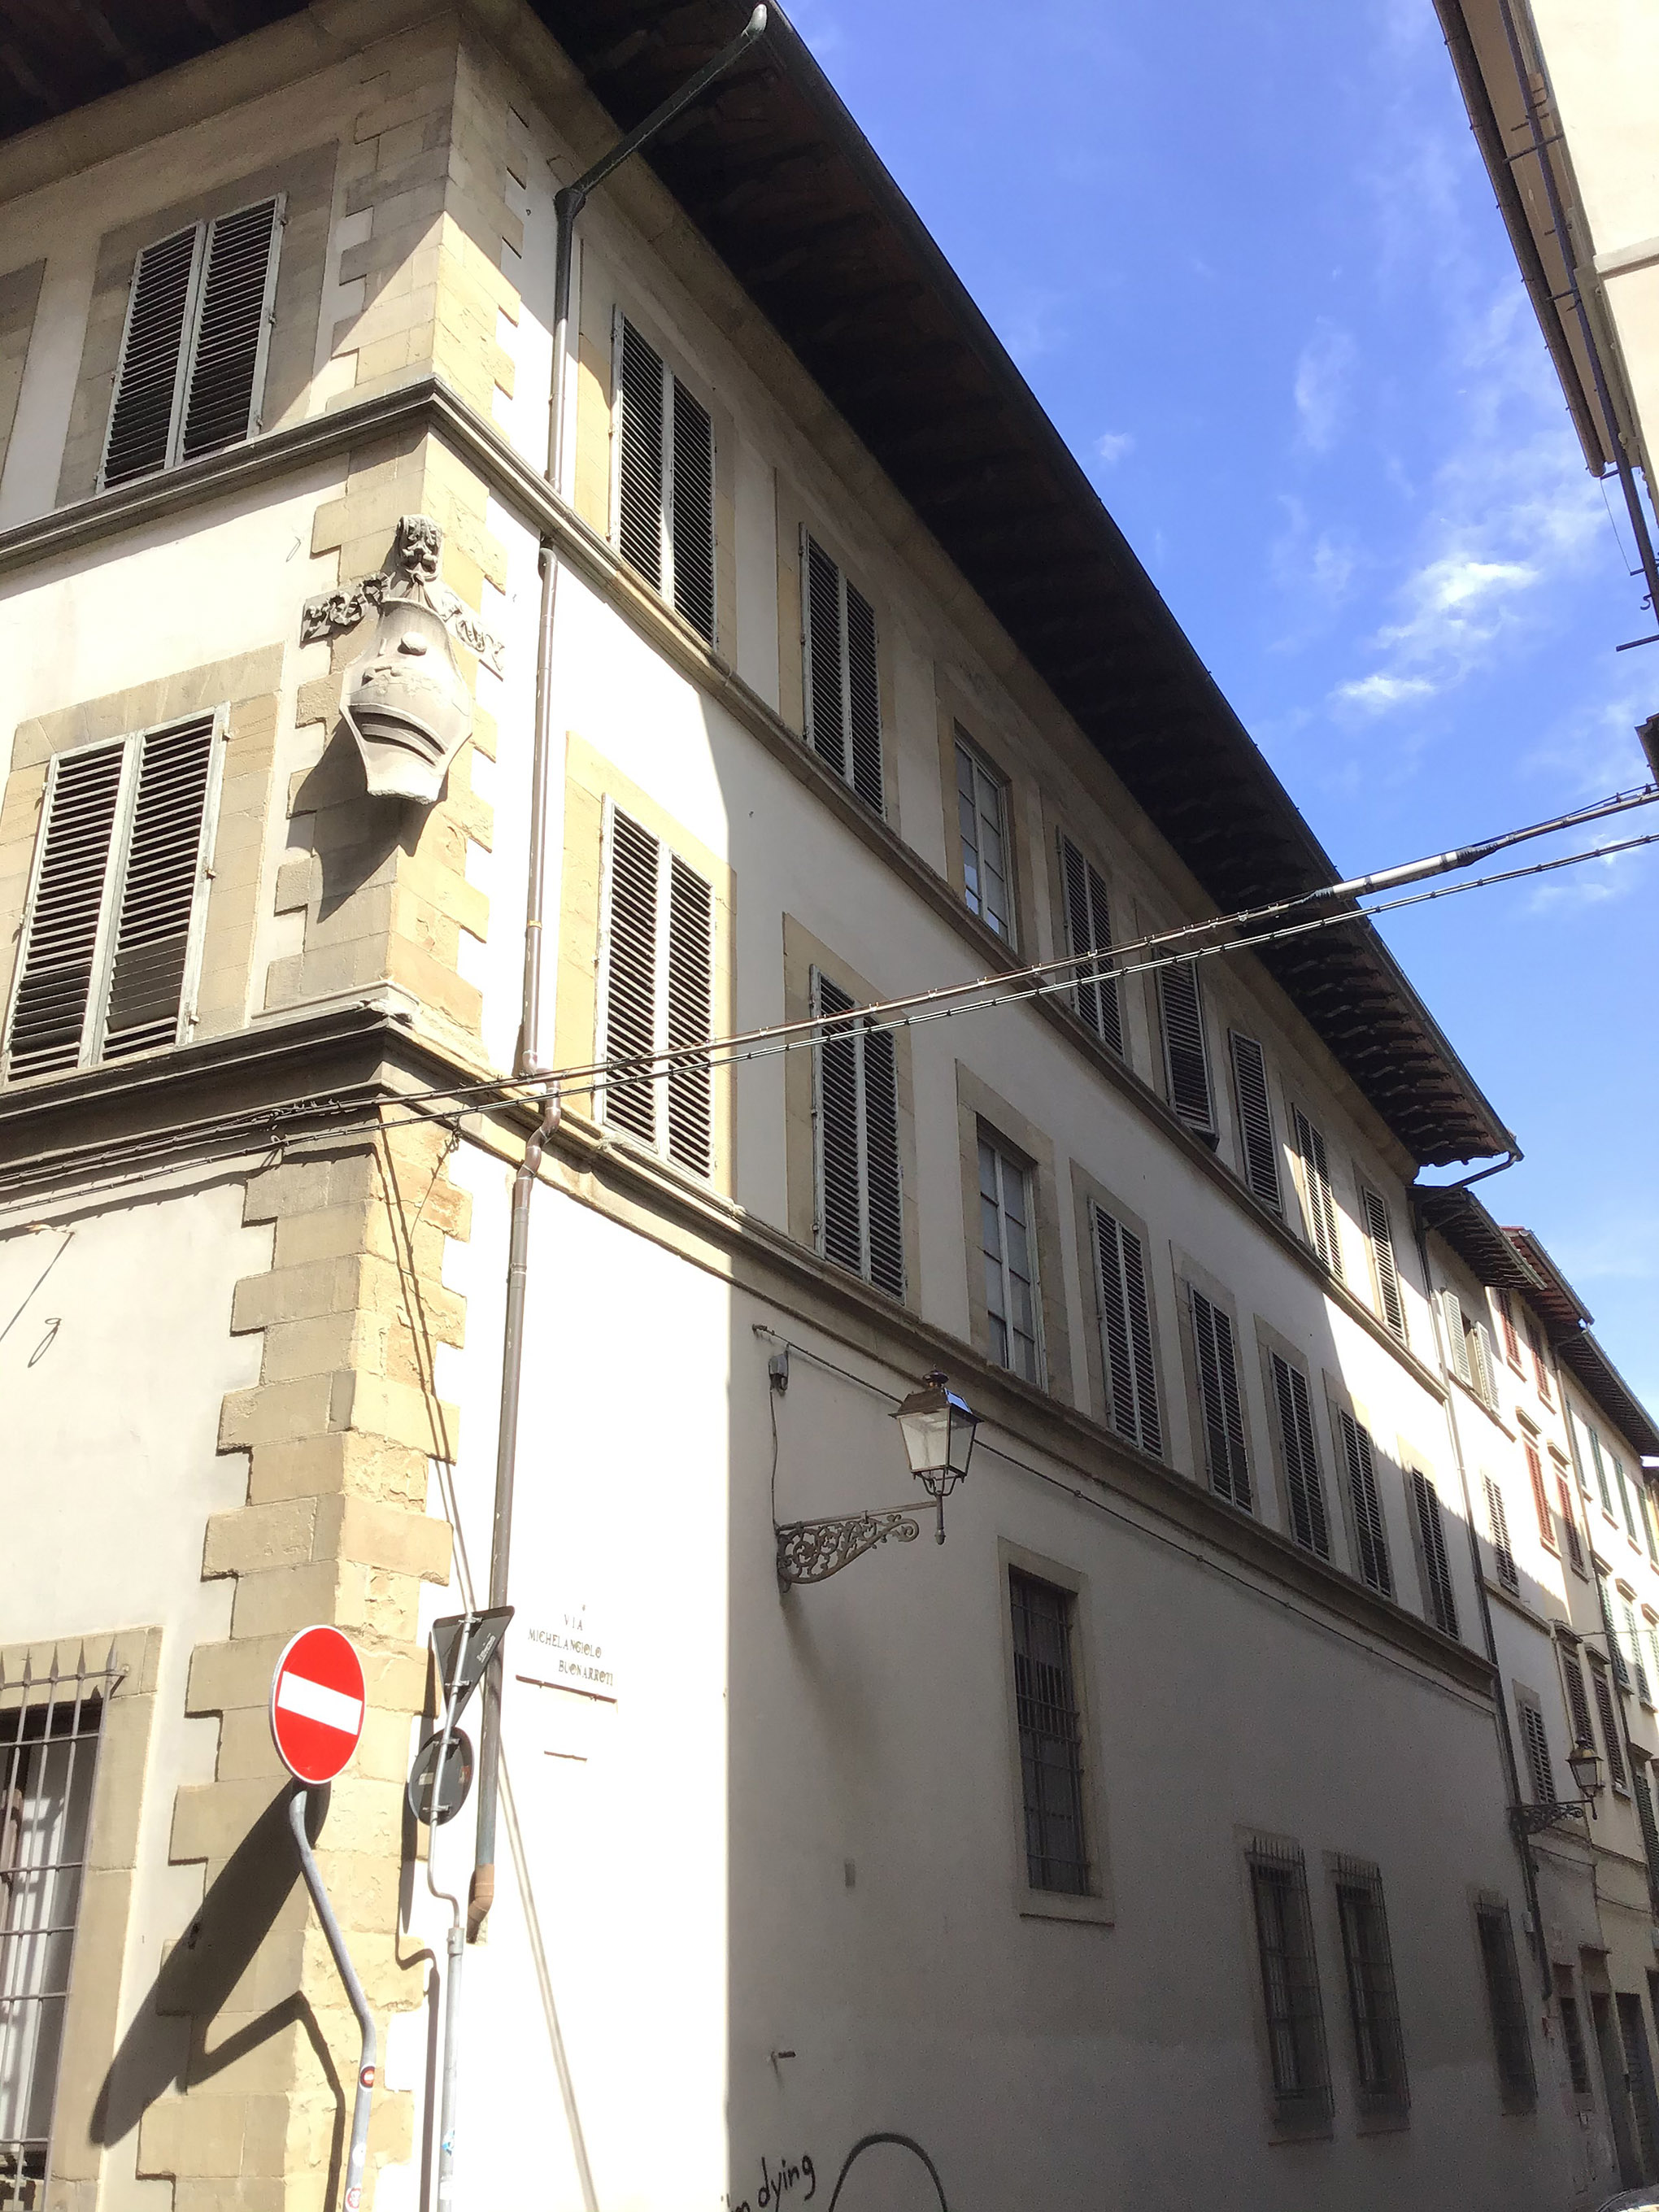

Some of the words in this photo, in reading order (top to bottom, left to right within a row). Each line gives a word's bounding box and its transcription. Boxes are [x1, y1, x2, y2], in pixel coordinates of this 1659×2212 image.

[564, 1613, 583, 1631] VIA
[528, 1628, 602, 1658] MICHELANGIOLO
[558, 1660, 613, 1686] BUONARROTI
[758, 2155, 816, 2212] dying
